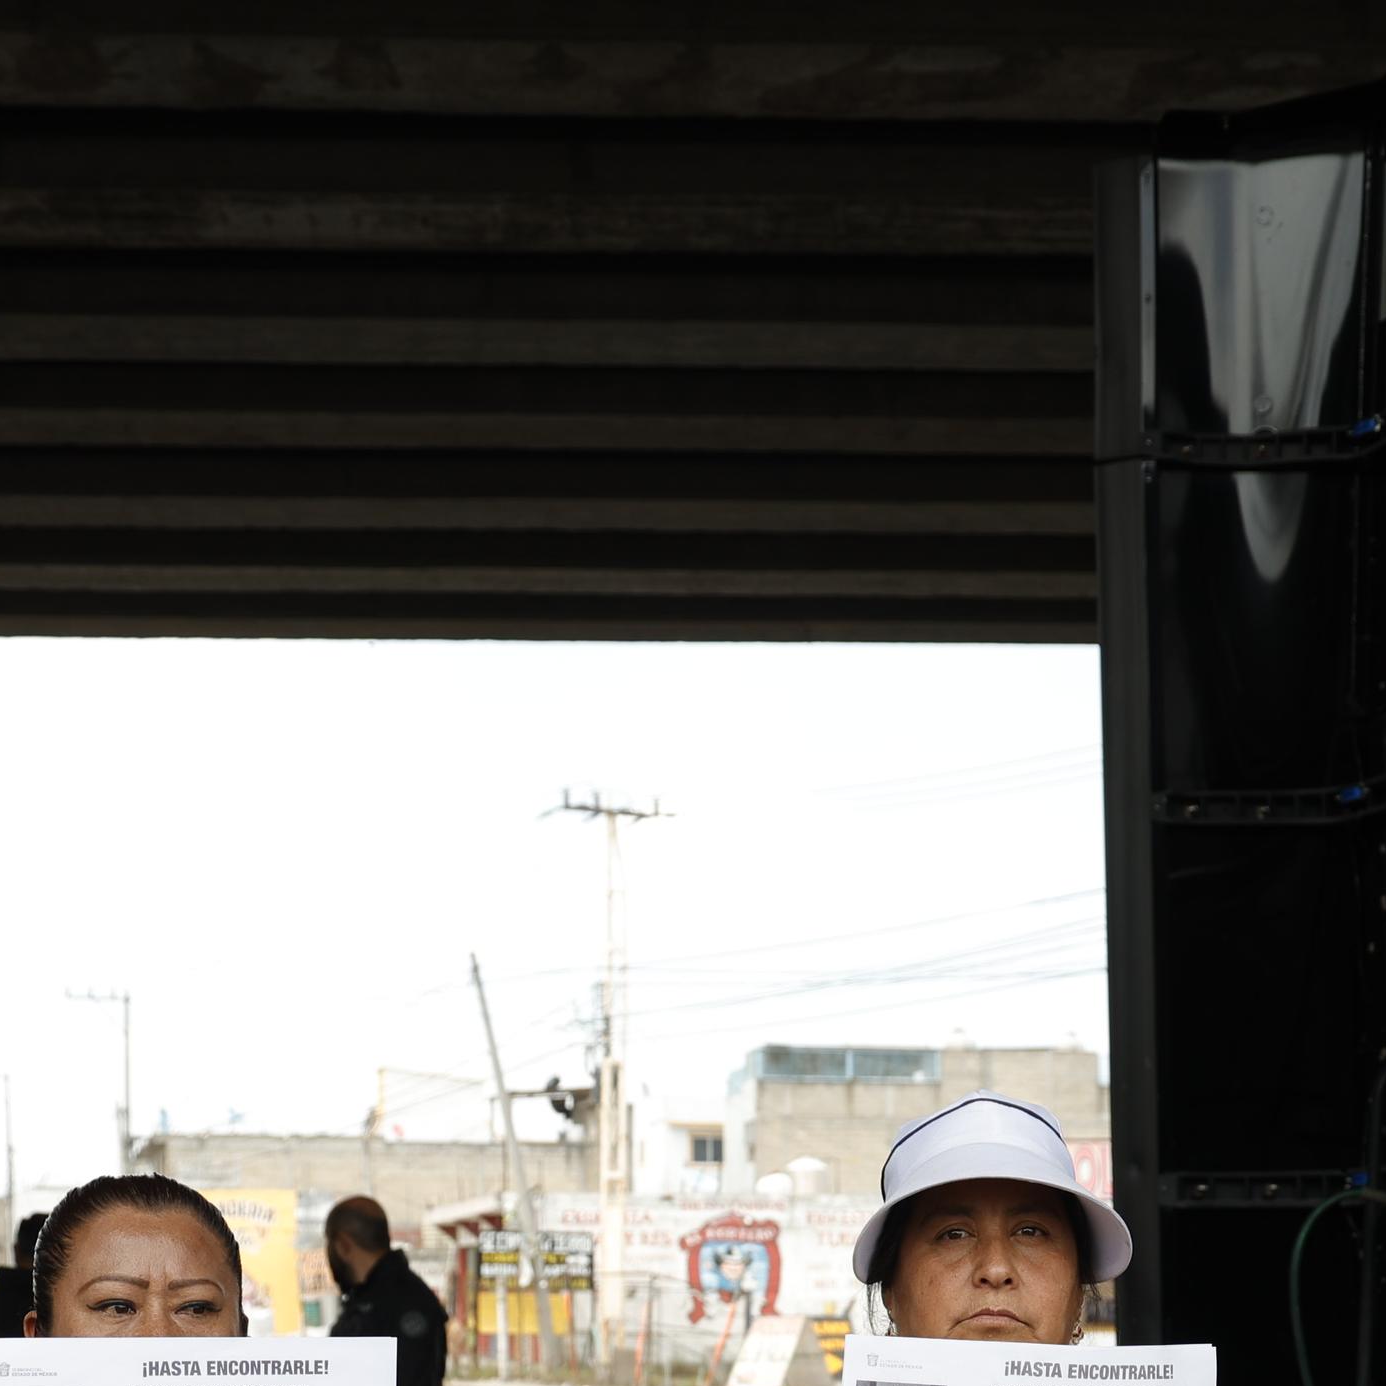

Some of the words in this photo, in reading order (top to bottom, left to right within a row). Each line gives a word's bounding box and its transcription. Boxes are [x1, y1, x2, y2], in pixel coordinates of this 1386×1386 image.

[143, 1360, 201, 1377] ¡HASTA
[206, 1360, 328, 1375] ENCONTRARLE!
[1005, 1359, 1062, 1380] ¡HASTA
[1067, 1363, 1173, 1380] ENCONTRARLE!
